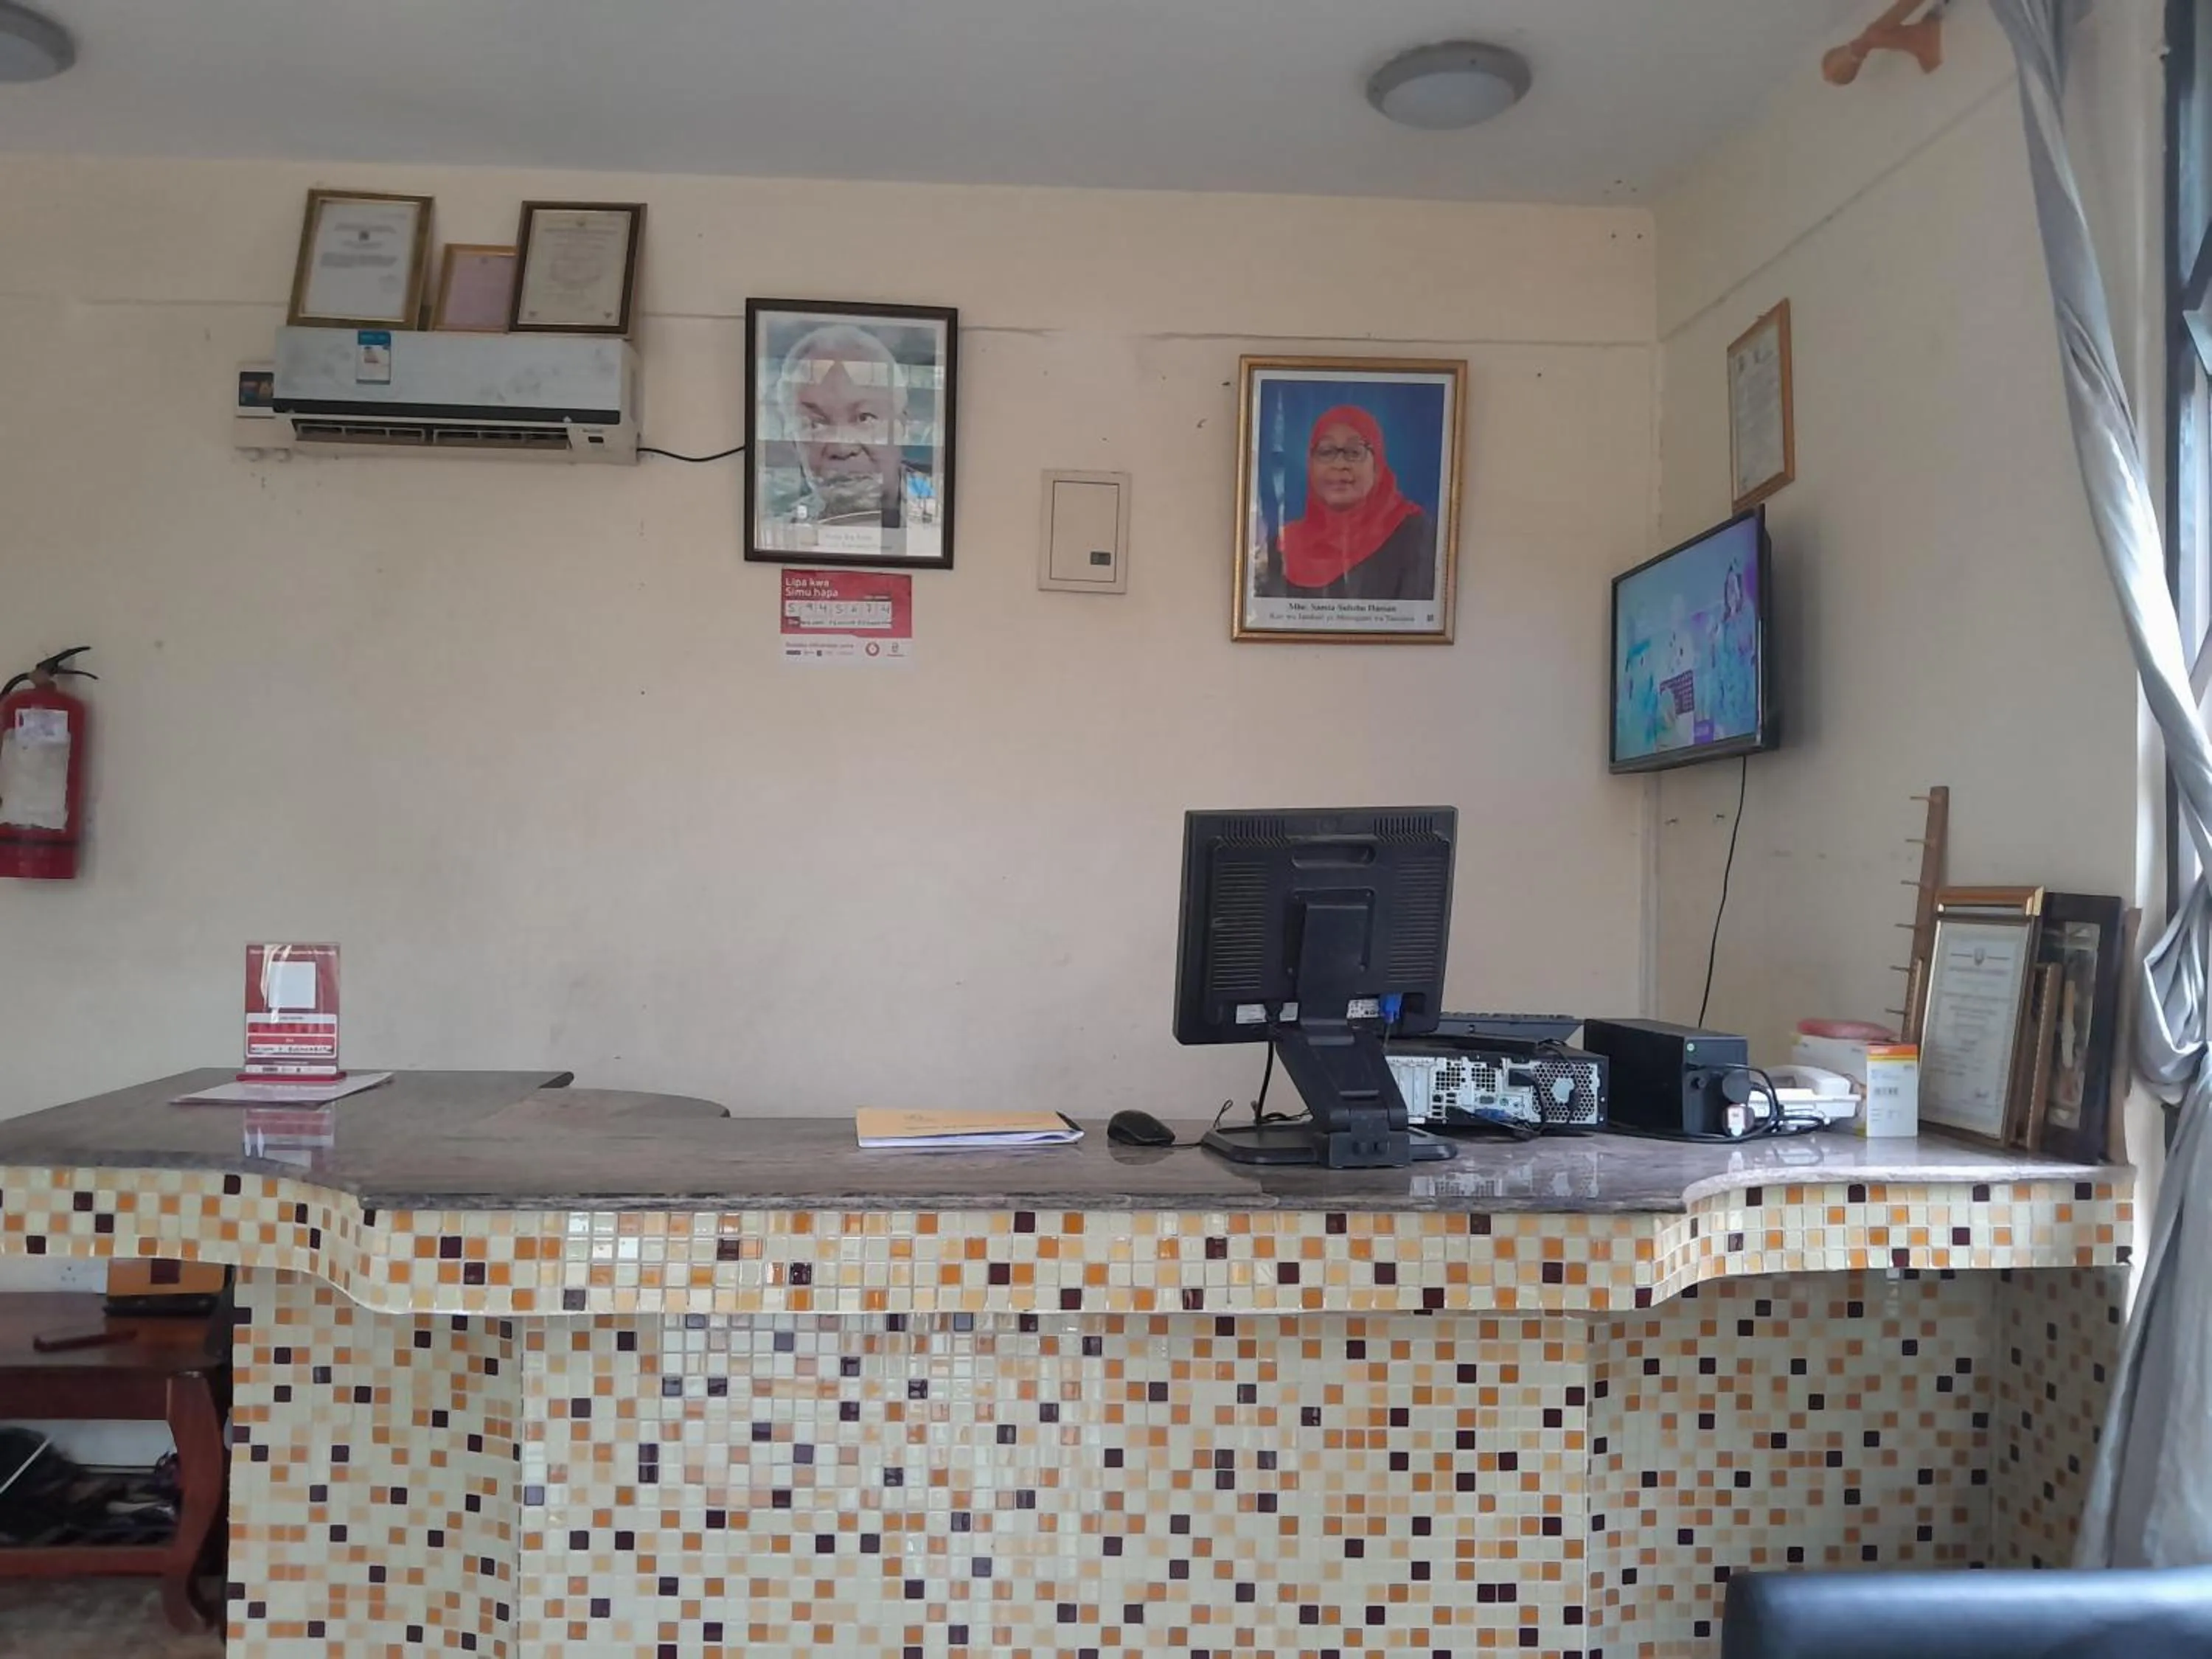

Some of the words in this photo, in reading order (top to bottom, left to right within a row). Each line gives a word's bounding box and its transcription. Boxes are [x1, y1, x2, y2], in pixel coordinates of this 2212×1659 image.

[785, 578, 807, 588] Lipa
[810, 578, 829, 587] kwa
[785, 587, 813, 597] Simu
[814, 588, 838, 598] hapa
